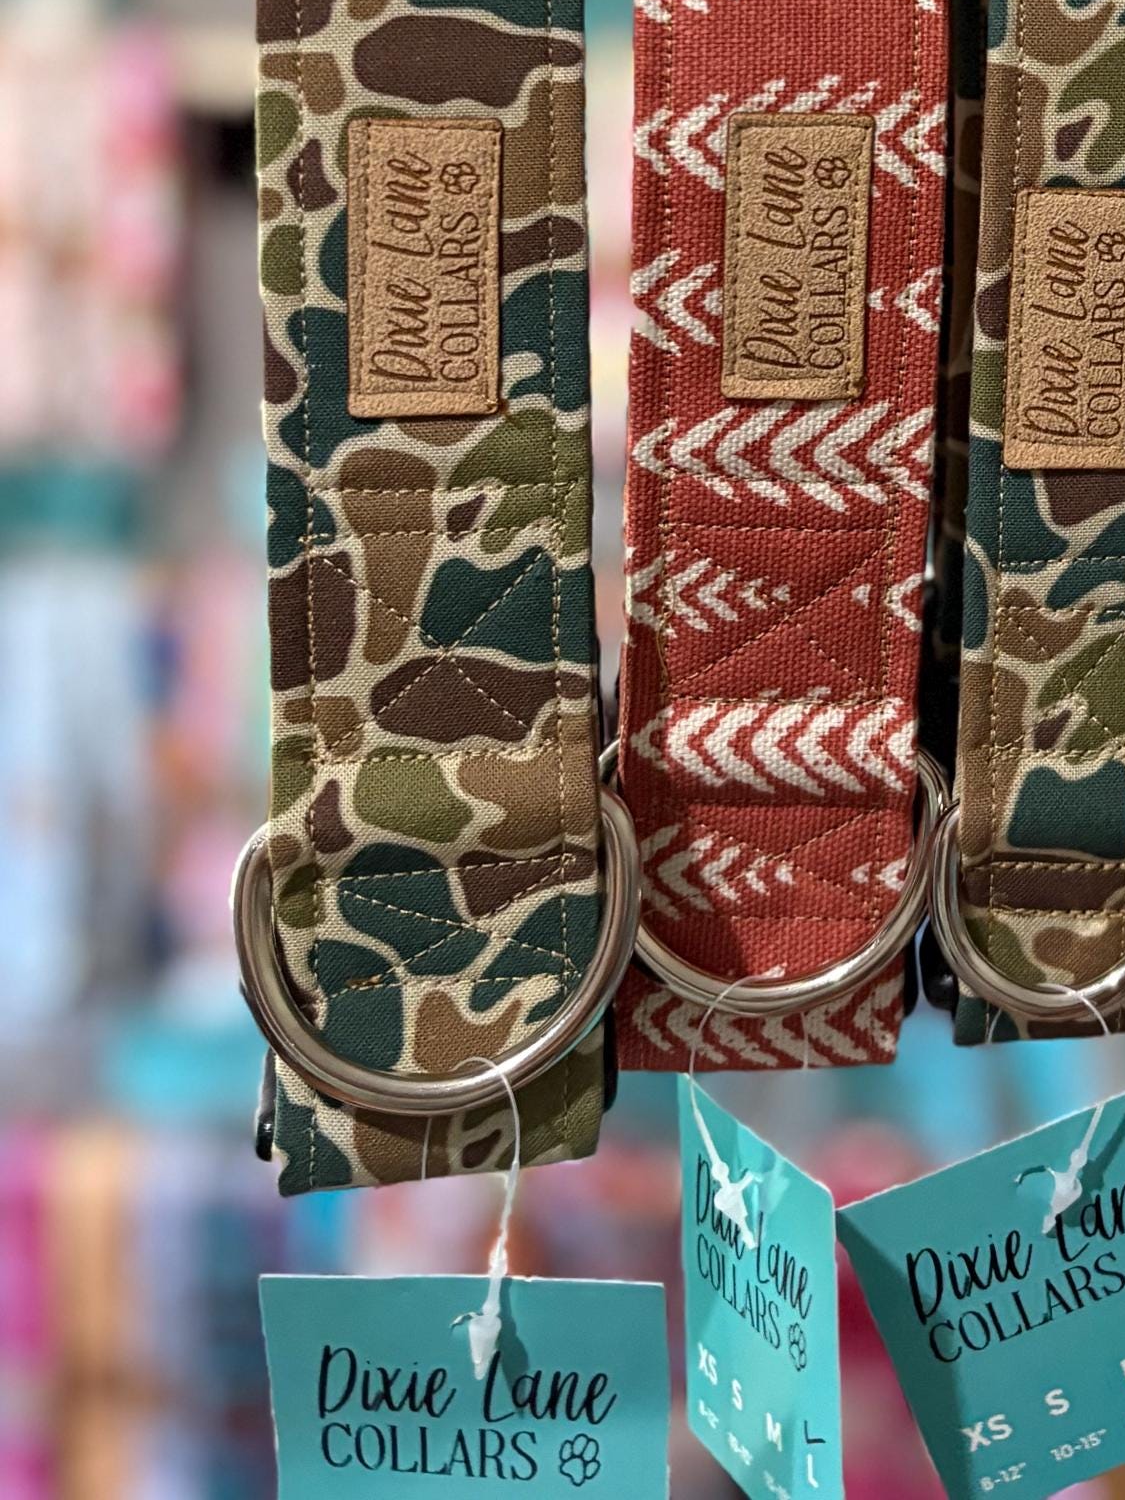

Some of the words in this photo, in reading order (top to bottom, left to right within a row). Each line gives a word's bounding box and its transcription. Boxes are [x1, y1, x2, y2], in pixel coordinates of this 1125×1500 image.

[370, 151, 434, 257] Lane
[746, 145, 808, 249] Lane
[439, 211, 482, 383] COLLARS
[741, 269, 807, 370] Dixie
[807, 205, 849, 370] COLLARS
[1030, 220, 1090, 321] Lane
[369, 277, 438, 382] Dixie
[1023, 339, 1084, 437] Dixie
[696, 1232, 782, 1350] COLLARS
[756, 1210, 811, 1320] Lane
[906, 1230, 1033, 1325] Dixie
[318, 1344, 457, 1419] Dixie
[482, 1350, 618, 1425] Lane
[698, 1342, 719, 1386] XS
[732, 1379, 743, 1412] S
[766, 1411, 783, 1453] M
[807, 1453, 819, 1489] L
[961, 1414, 1013, 1453] XS
[1044, 1388, 1071, 1417] S
[320, 1422, 539, 1481] COLLARS
